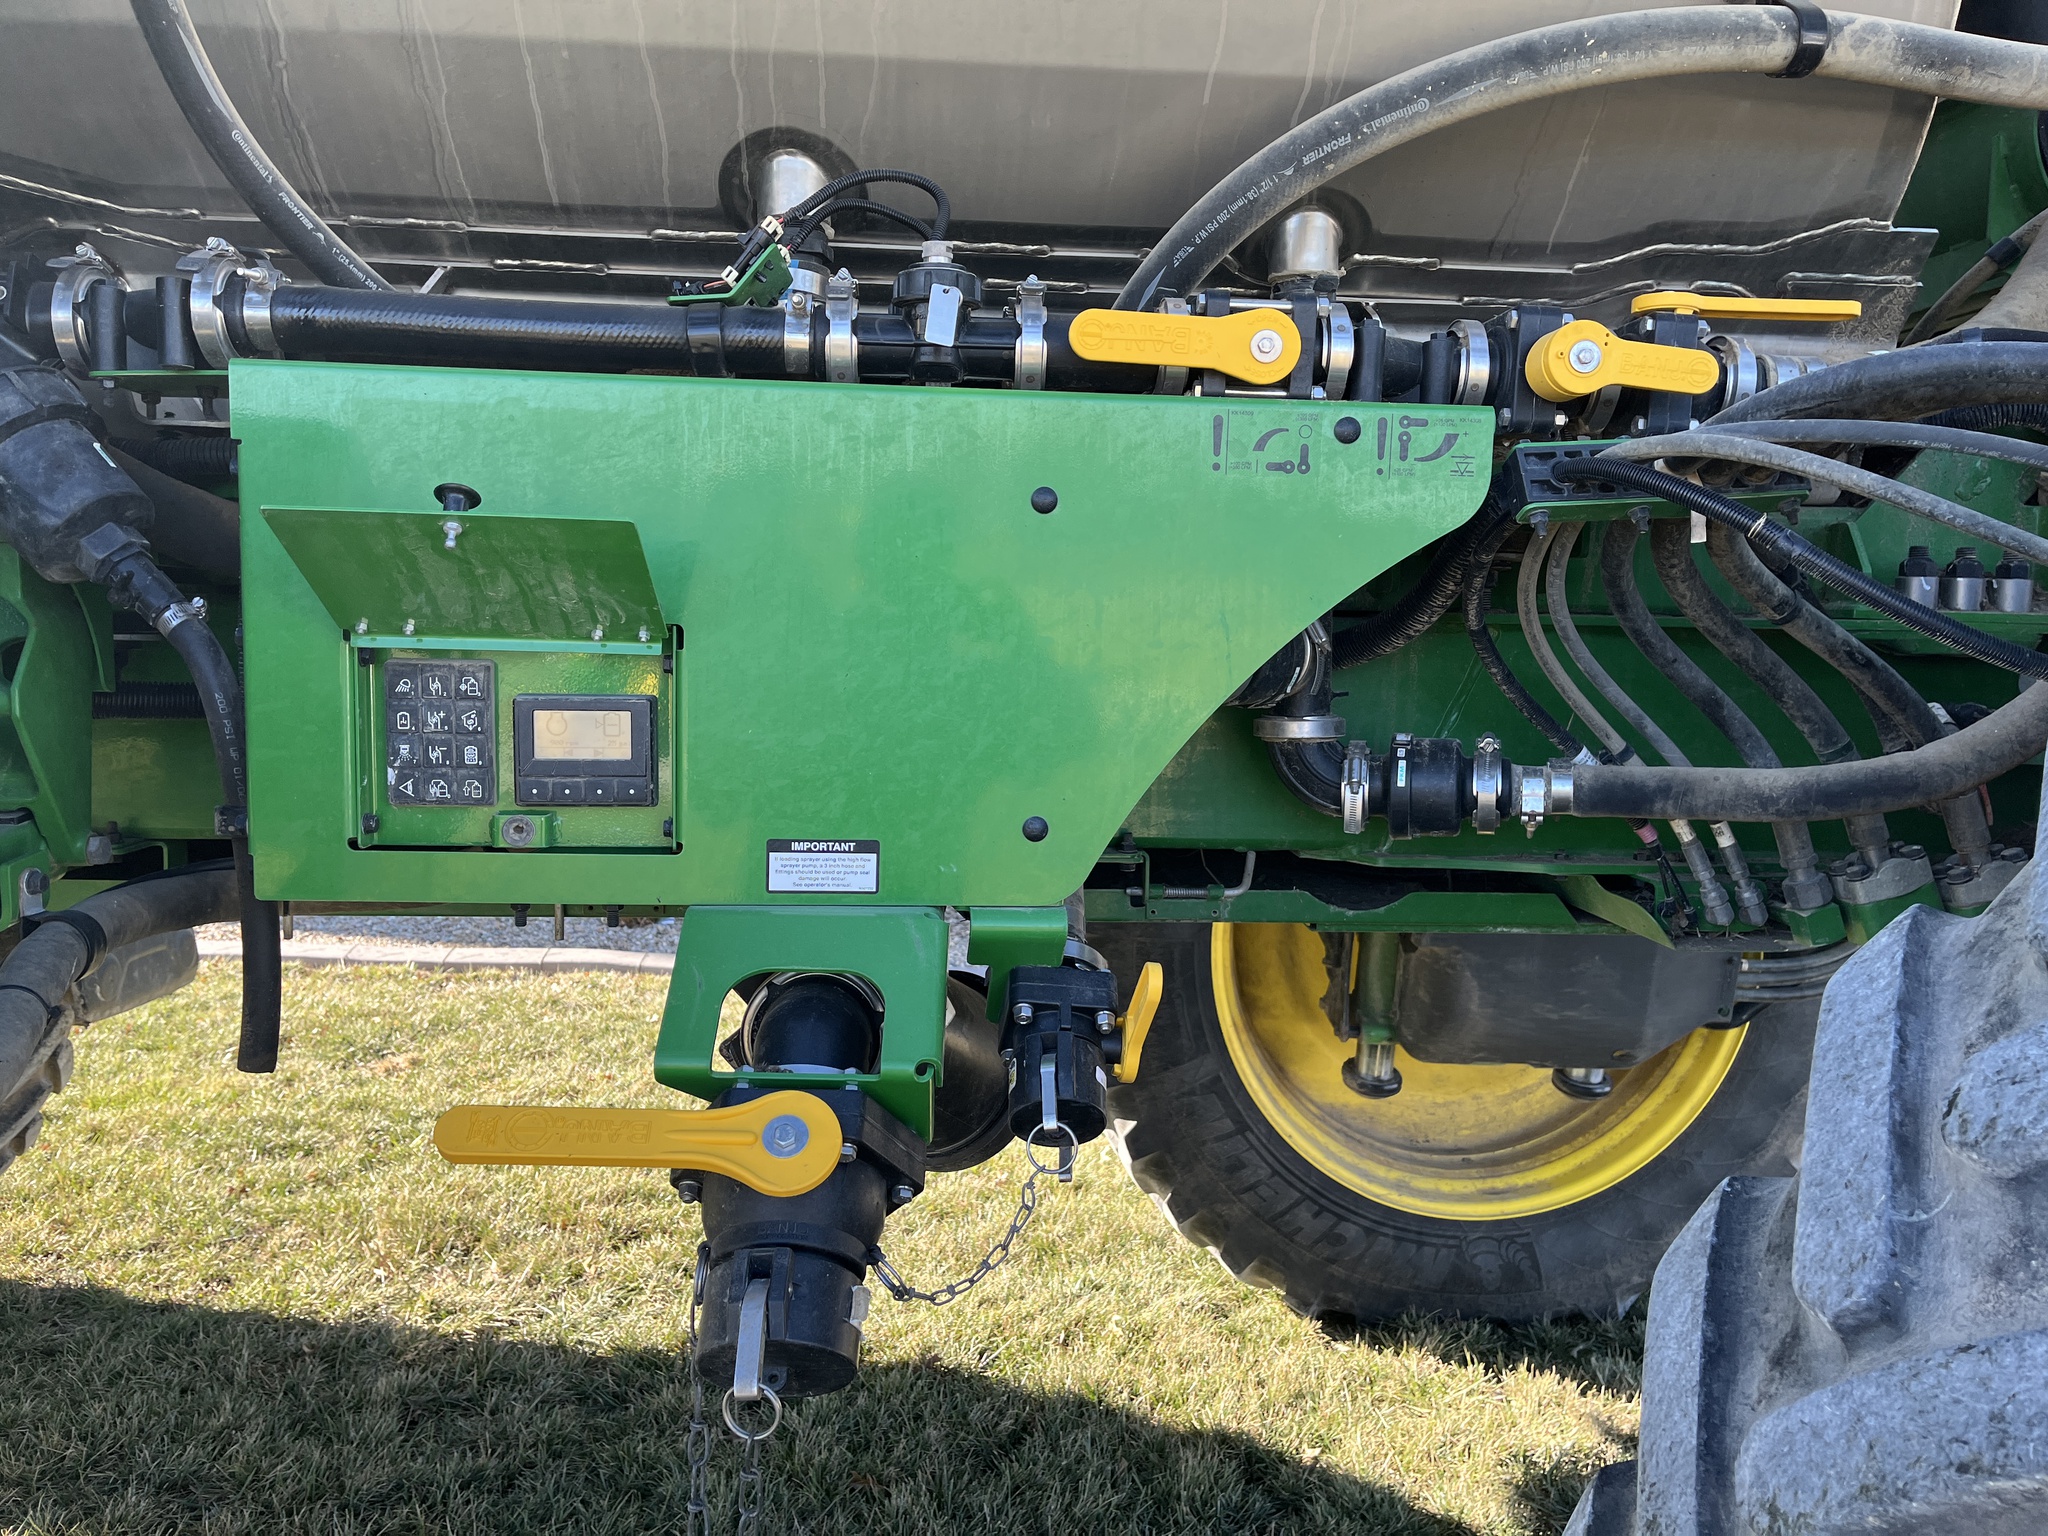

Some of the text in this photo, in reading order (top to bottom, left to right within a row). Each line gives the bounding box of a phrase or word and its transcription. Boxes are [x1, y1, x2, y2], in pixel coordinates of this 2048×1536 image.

[1576, 60, 1590, 69] 200
[1369, 98, 1430, 134] Continental
[232, 130, 268, 180] Continental
[1302, 132, 1352, 166] FRONTIER
[278, 192, 314, 230] FRONTIER
[1228, 186, 1259, 213] (38.1mm)
[1205, 219, 1219, 232] PSI
[1216, 209, 1230, 223] 200
[338, 254, 366, 282] (25.4mm)
[1620, 352, 1714, 388] BANJO
[214, 692, 228, 714] 200
[223, 719, 235, 740] PSI
[230, 747, 240, 761] WP
[791, 842, 856, 852] IMPORTANT
[504, 1108, 652, 1152] BANJO
[757, 1222, 809, 1234] BANJO
